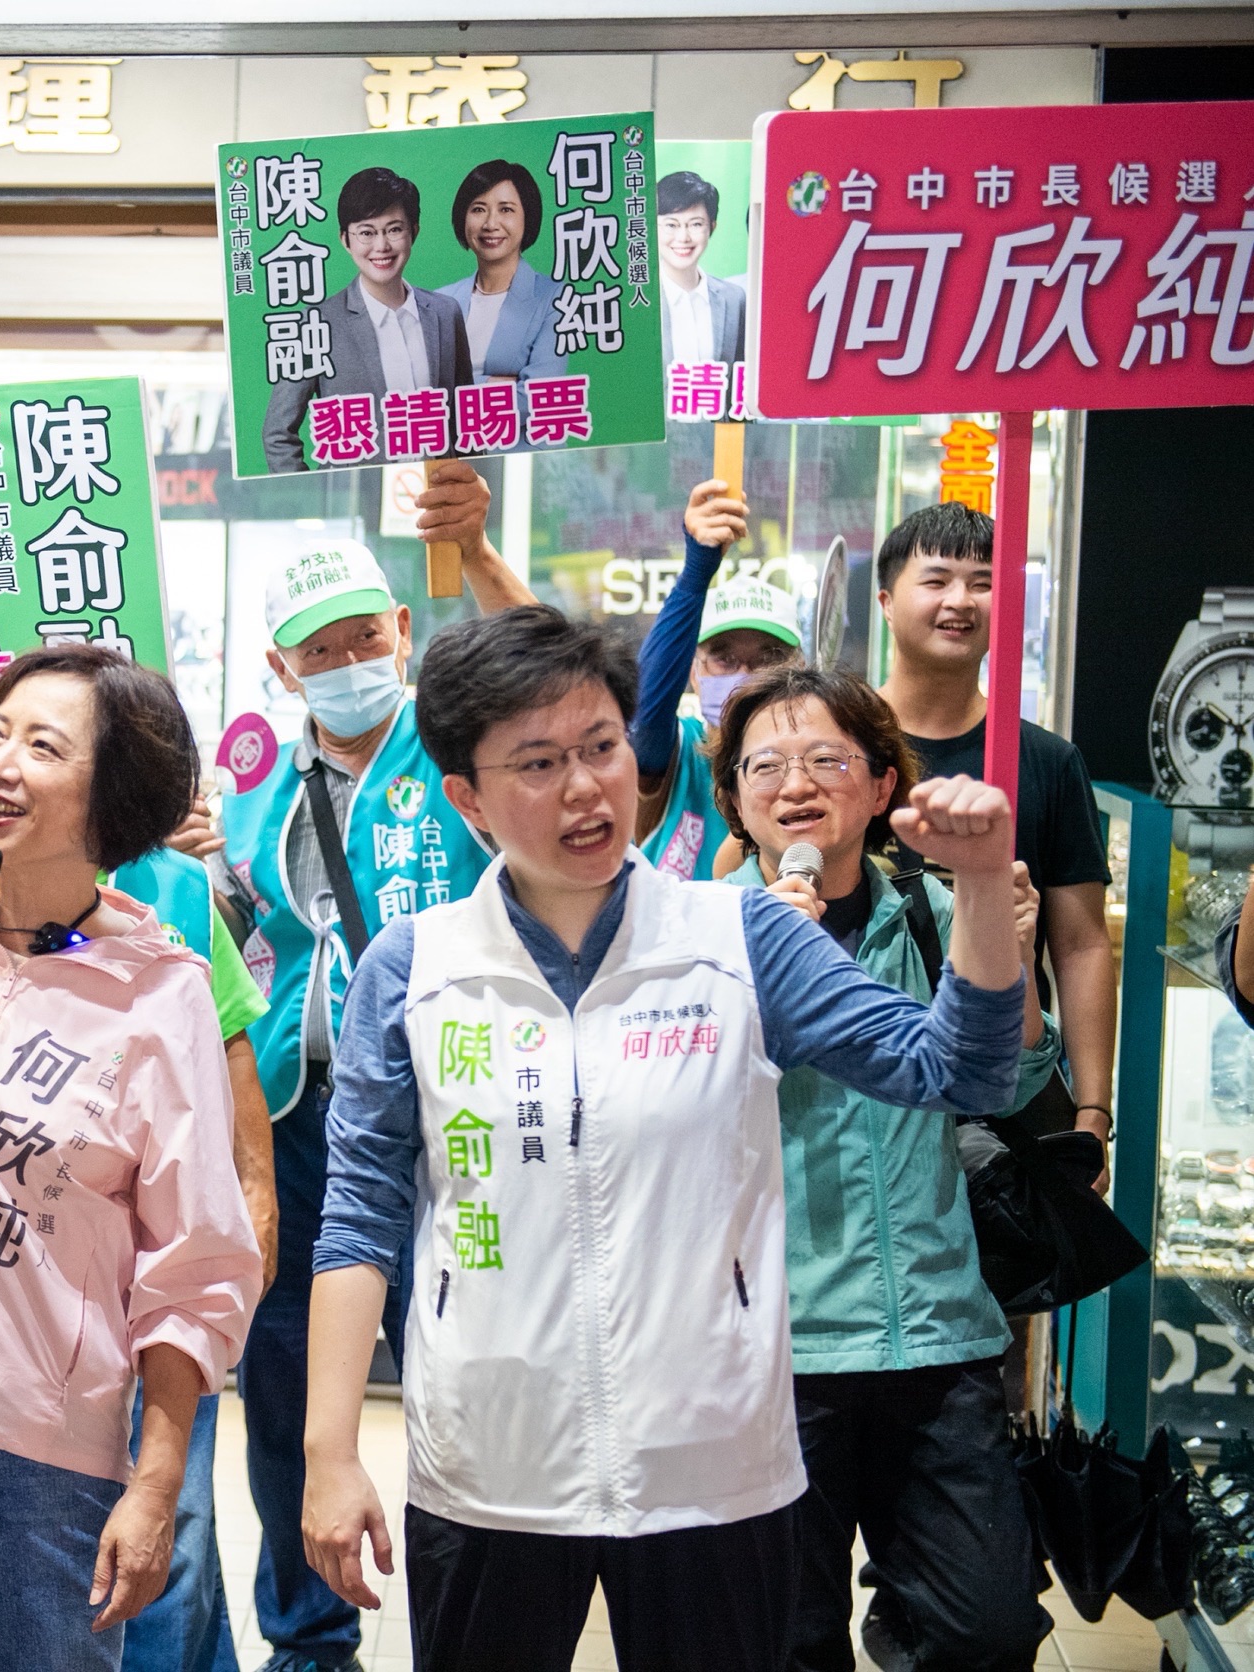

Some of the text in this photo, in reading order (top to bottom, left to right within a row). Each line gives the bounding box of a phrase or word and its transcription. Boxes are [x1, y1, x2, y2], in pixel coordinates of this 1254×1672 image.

[228, 181, 254, 295] 台中市議員
[549, 132, 623, 355] 何欣純
[624, 150, 650, 308] 台中市長候選人
[839, 161, 1254, 213] 台中市長候選
[255, 154, 334, 384] 陳俞融
[807, 211, 1254, 381] 何欣純
[313, 378, 591, 464] 懇請賜票
[419, 814, 451, 906] 台中市
[620, 1003, 718, 1027] 台中市長候選人
[622, 1023, 719, 1060] 何欣純
[35, 1067, 118, 1271] 台中市長候選人
[439, 1020, 504, 1272] 陳俞融
[515, 1066, 546, 1164] 市議員
